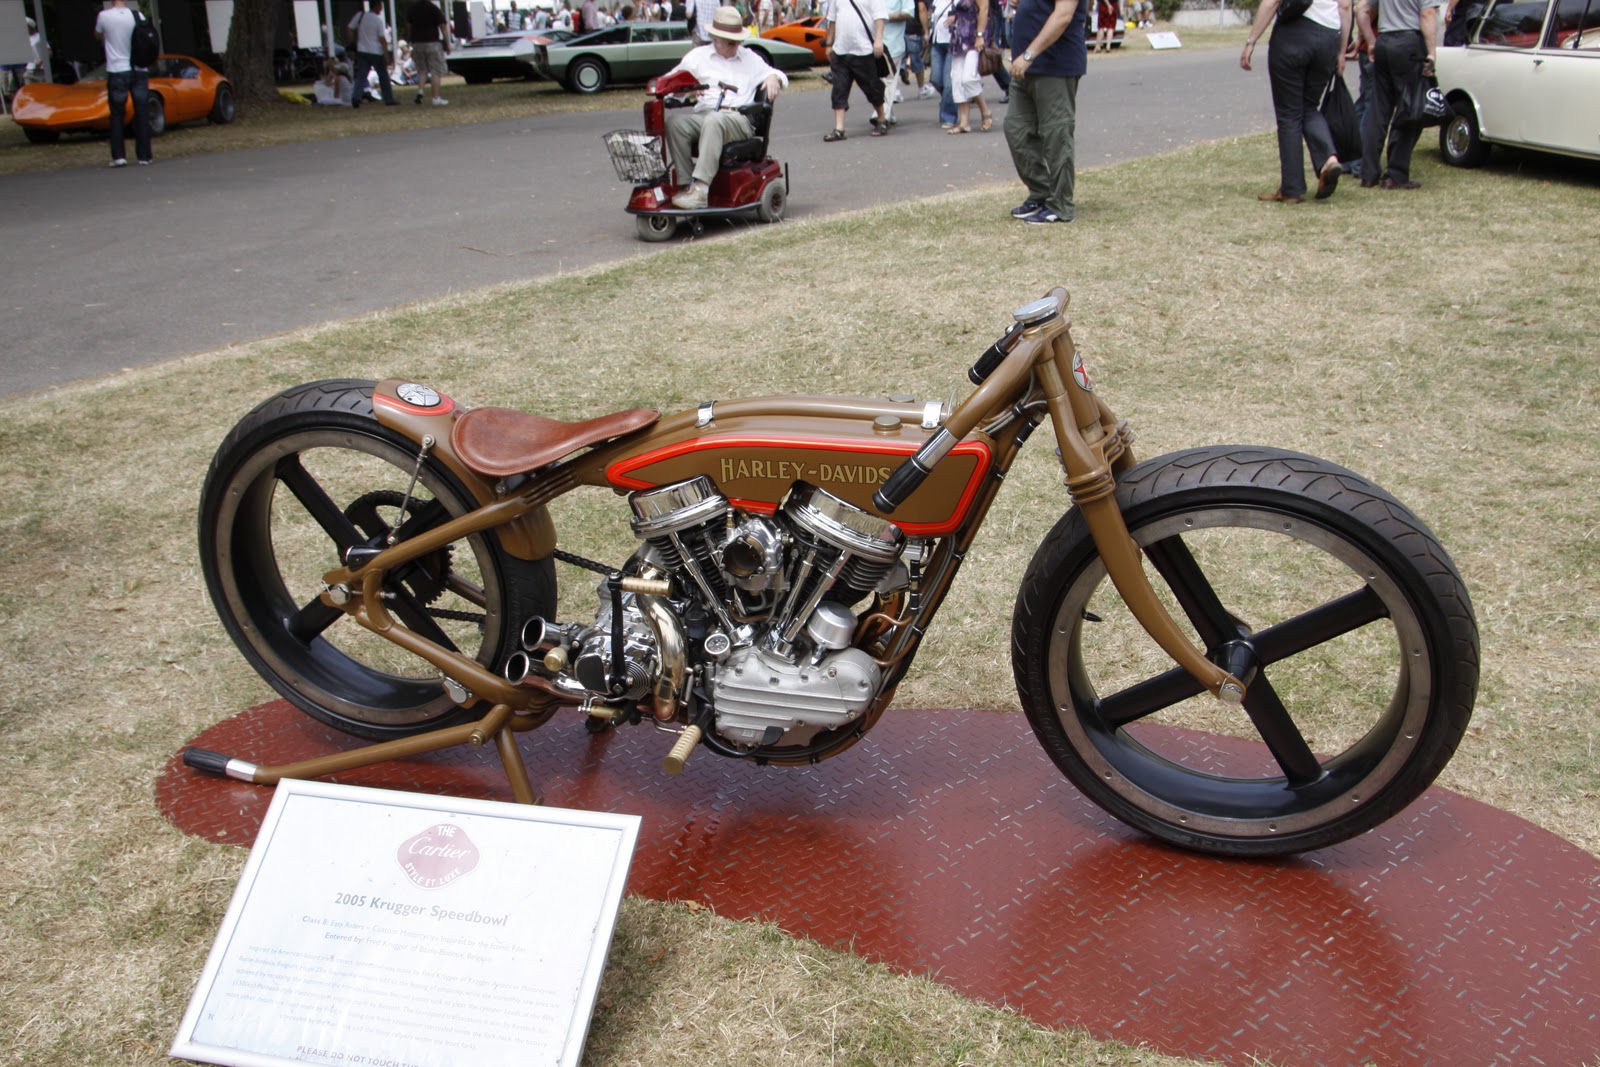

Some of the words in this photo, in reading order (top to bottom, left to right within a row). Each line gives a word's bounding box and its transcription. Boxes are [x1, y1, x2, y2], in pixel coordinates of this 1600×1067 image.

[719, 457, 897, 485] HARLEY-DAVIDS
[437, 826, 457, 837] THE
[408, 836, 471, 859] Cartier
[404, 862, 424, 884] STYLE
[424, 878, 437, 887] ET
[440, 867, 462, 885] LUXE
[334, 892, 367, 907] 2005
[369, 896, 427, 917] Krugger
[429, 904, 509, 927] Speedbowl
[301, 915, 320, 924] Class
[330, 919, 343, 928] Easy
[344, 920, 364, 930] Riders
[372, 923, 397, 934] Custom
[324, 931, 352, 942] Entered
[353, 935, 364, 945] by:
[365, 937, 380, 945] Fred
[296, 1045, 329, 1058] PLEASE
[330, 1051, 345, 1060] DO
[346, 1053, 367, 1064] NOT
[367, 1057, 400, 1067] TOUCH
